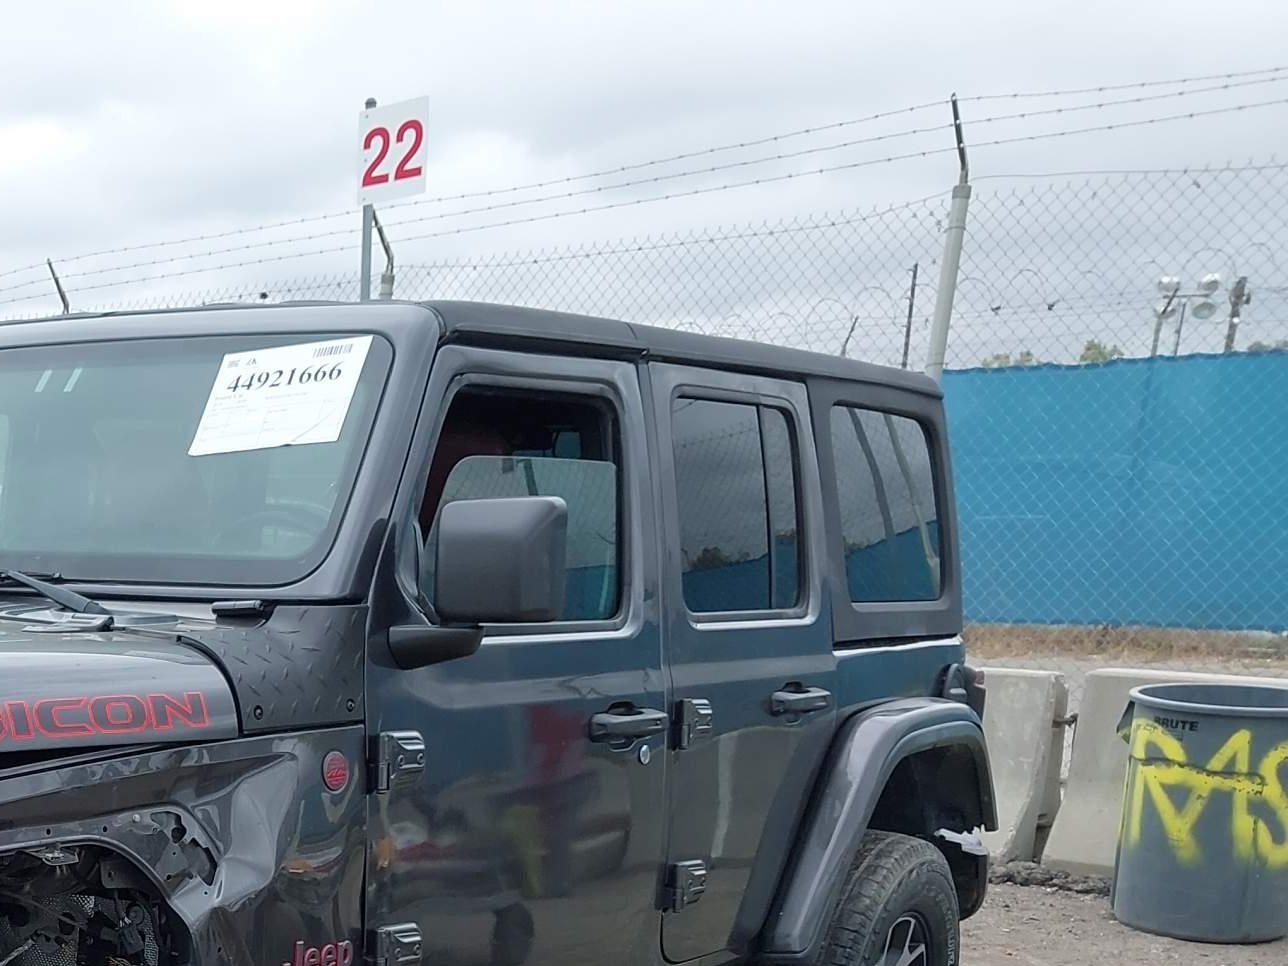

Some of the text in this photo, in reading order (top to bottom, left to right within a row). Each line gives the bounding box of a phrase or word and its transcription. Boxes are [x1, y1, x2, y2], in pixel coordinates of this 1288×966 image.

[361, 118, 425, 188] 22
[226, 360, 344, 392] 44921666
[1153, 716, 1199, 732] BRUTE
